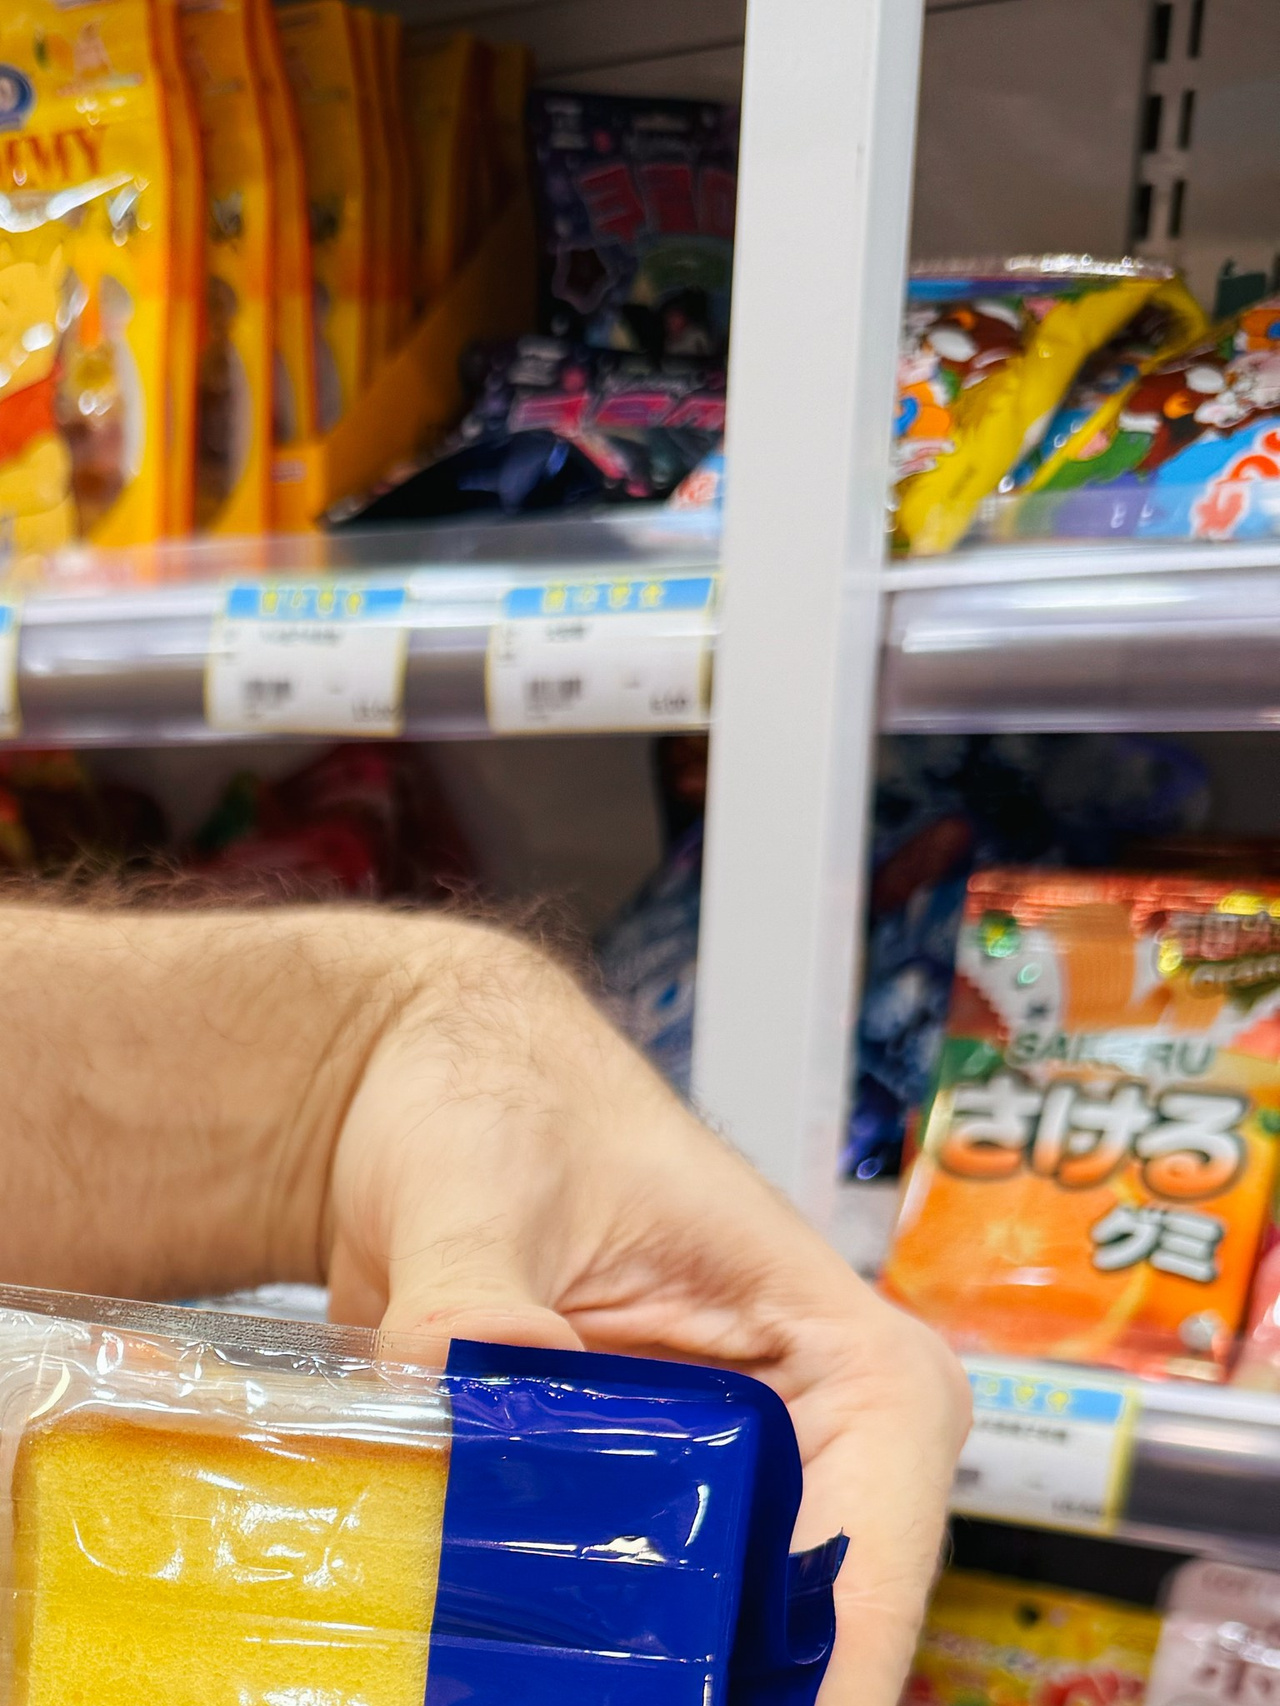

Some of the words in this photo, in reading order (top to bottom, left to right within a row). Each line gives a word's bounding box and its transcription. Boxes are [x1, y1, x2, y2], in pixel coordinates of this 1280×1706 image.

[939, 1076, 1247, 1200] さける
[1090, 1204, 1226, 1282] グミ
